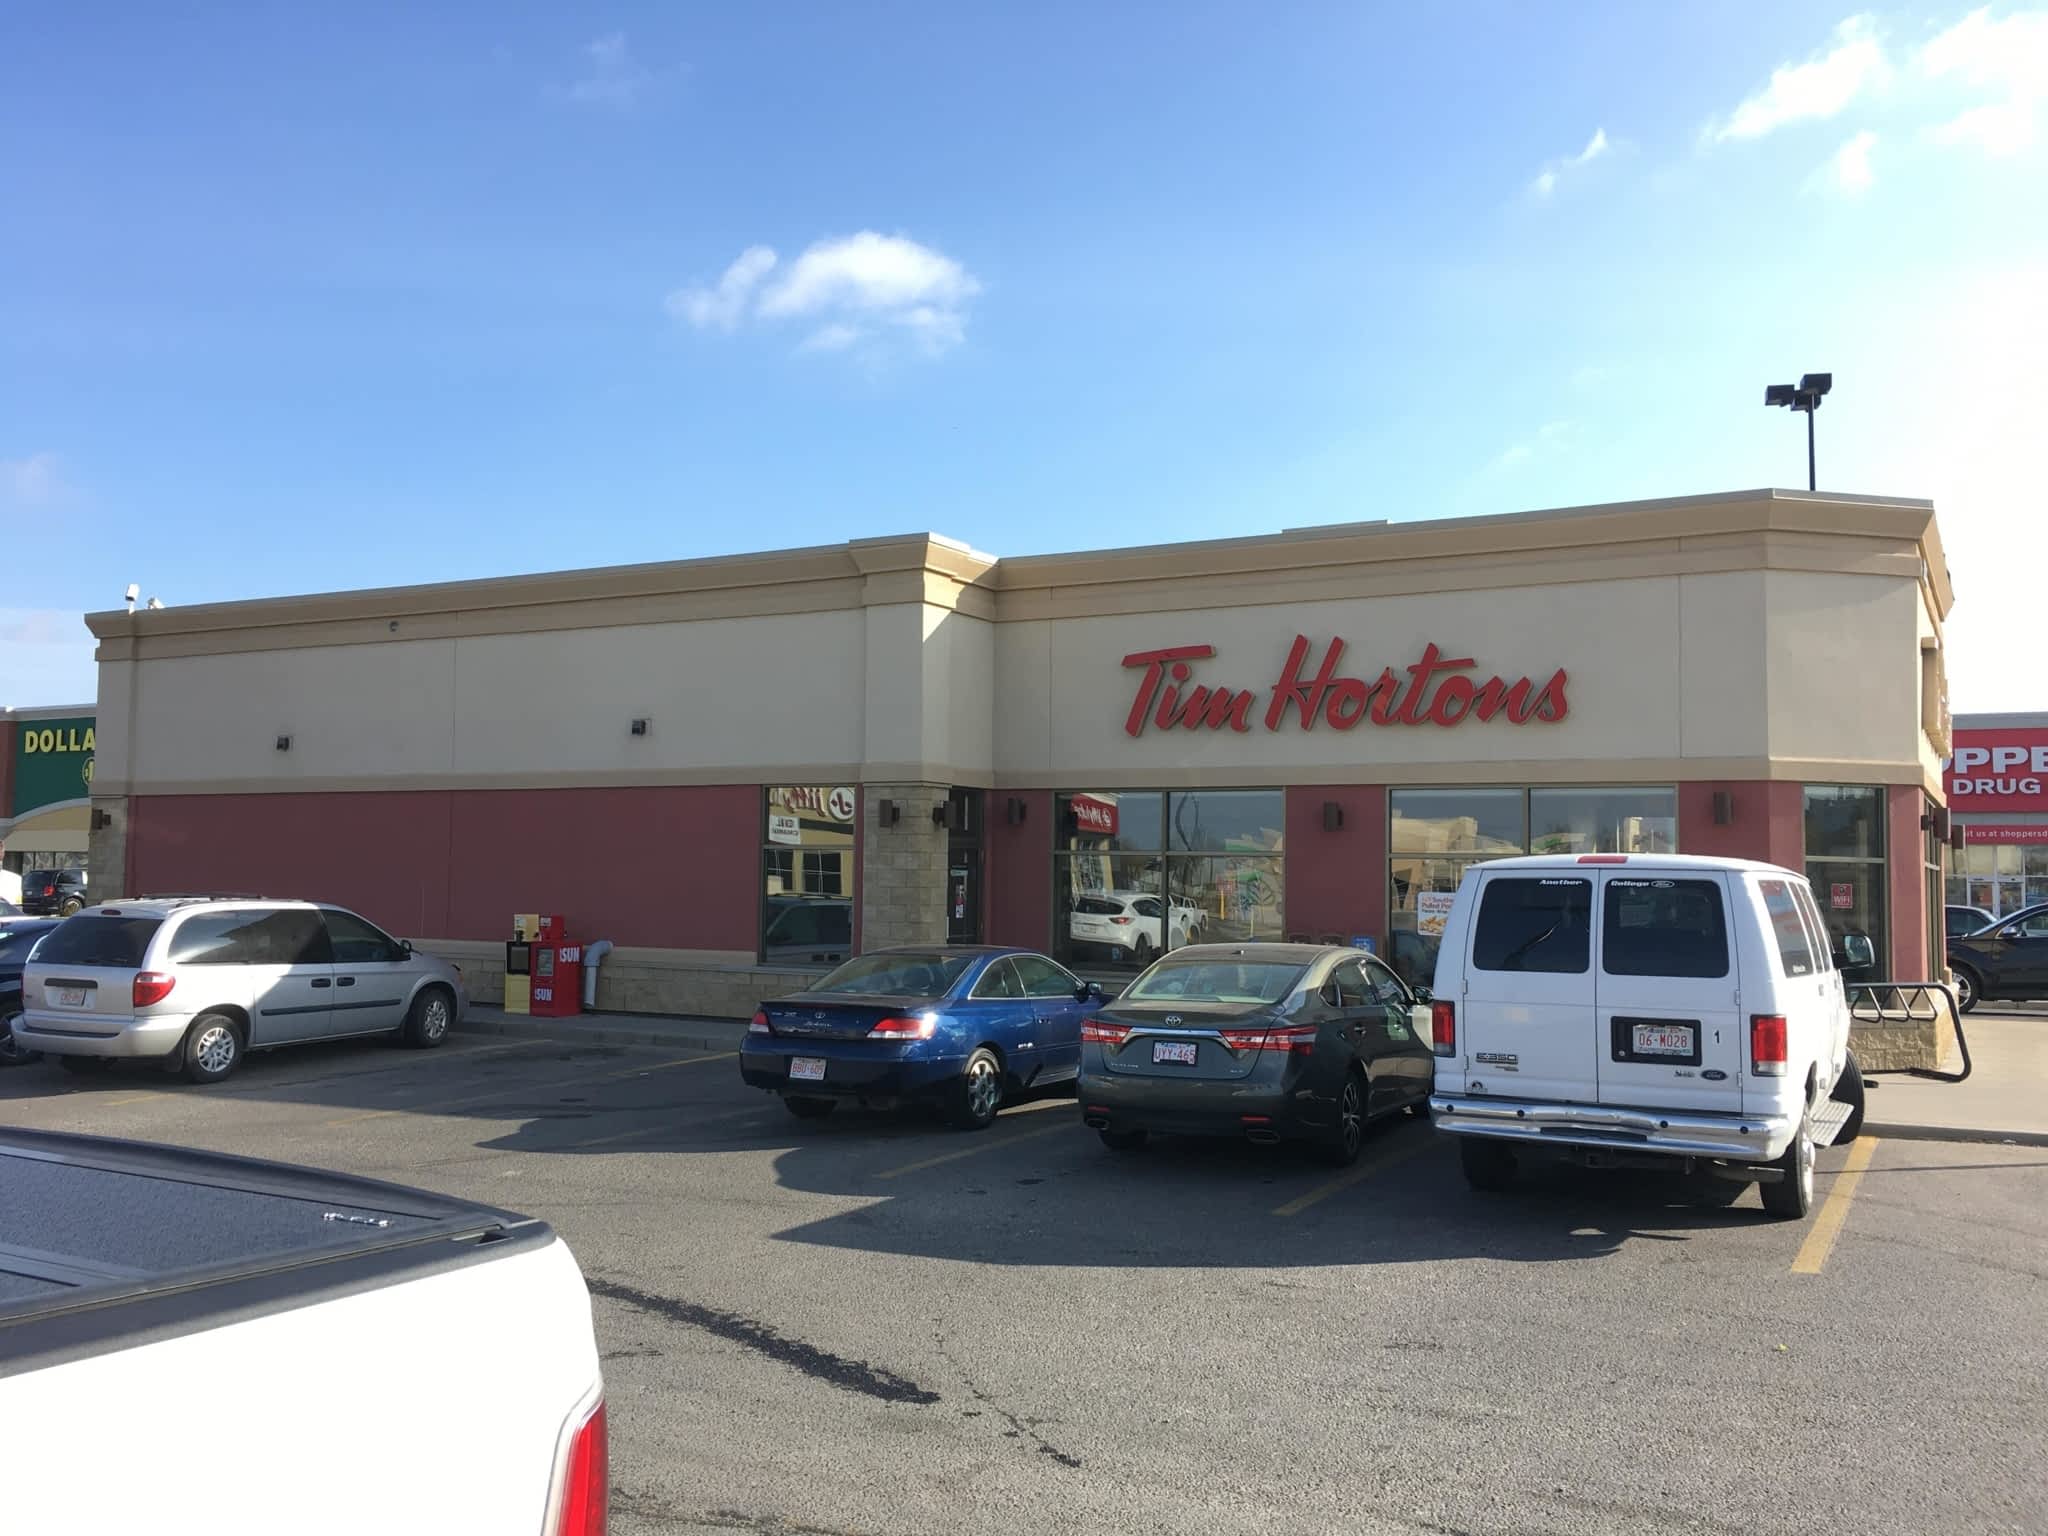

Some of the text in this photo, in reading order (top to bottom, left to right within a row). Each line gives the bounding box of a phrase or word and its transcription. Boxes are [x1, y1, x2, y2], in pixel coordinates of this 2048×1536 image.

[1121, 634, 1569, 738] Tim Hortons
[24, 728, 96, 753] DOLLA
[1952, 778, 2041, 795] DRUG
[561, 947, 580, 962] SUN
[535, 988, 552, 1001] SUN
[1714, 1030, 1720, 1043] 1
